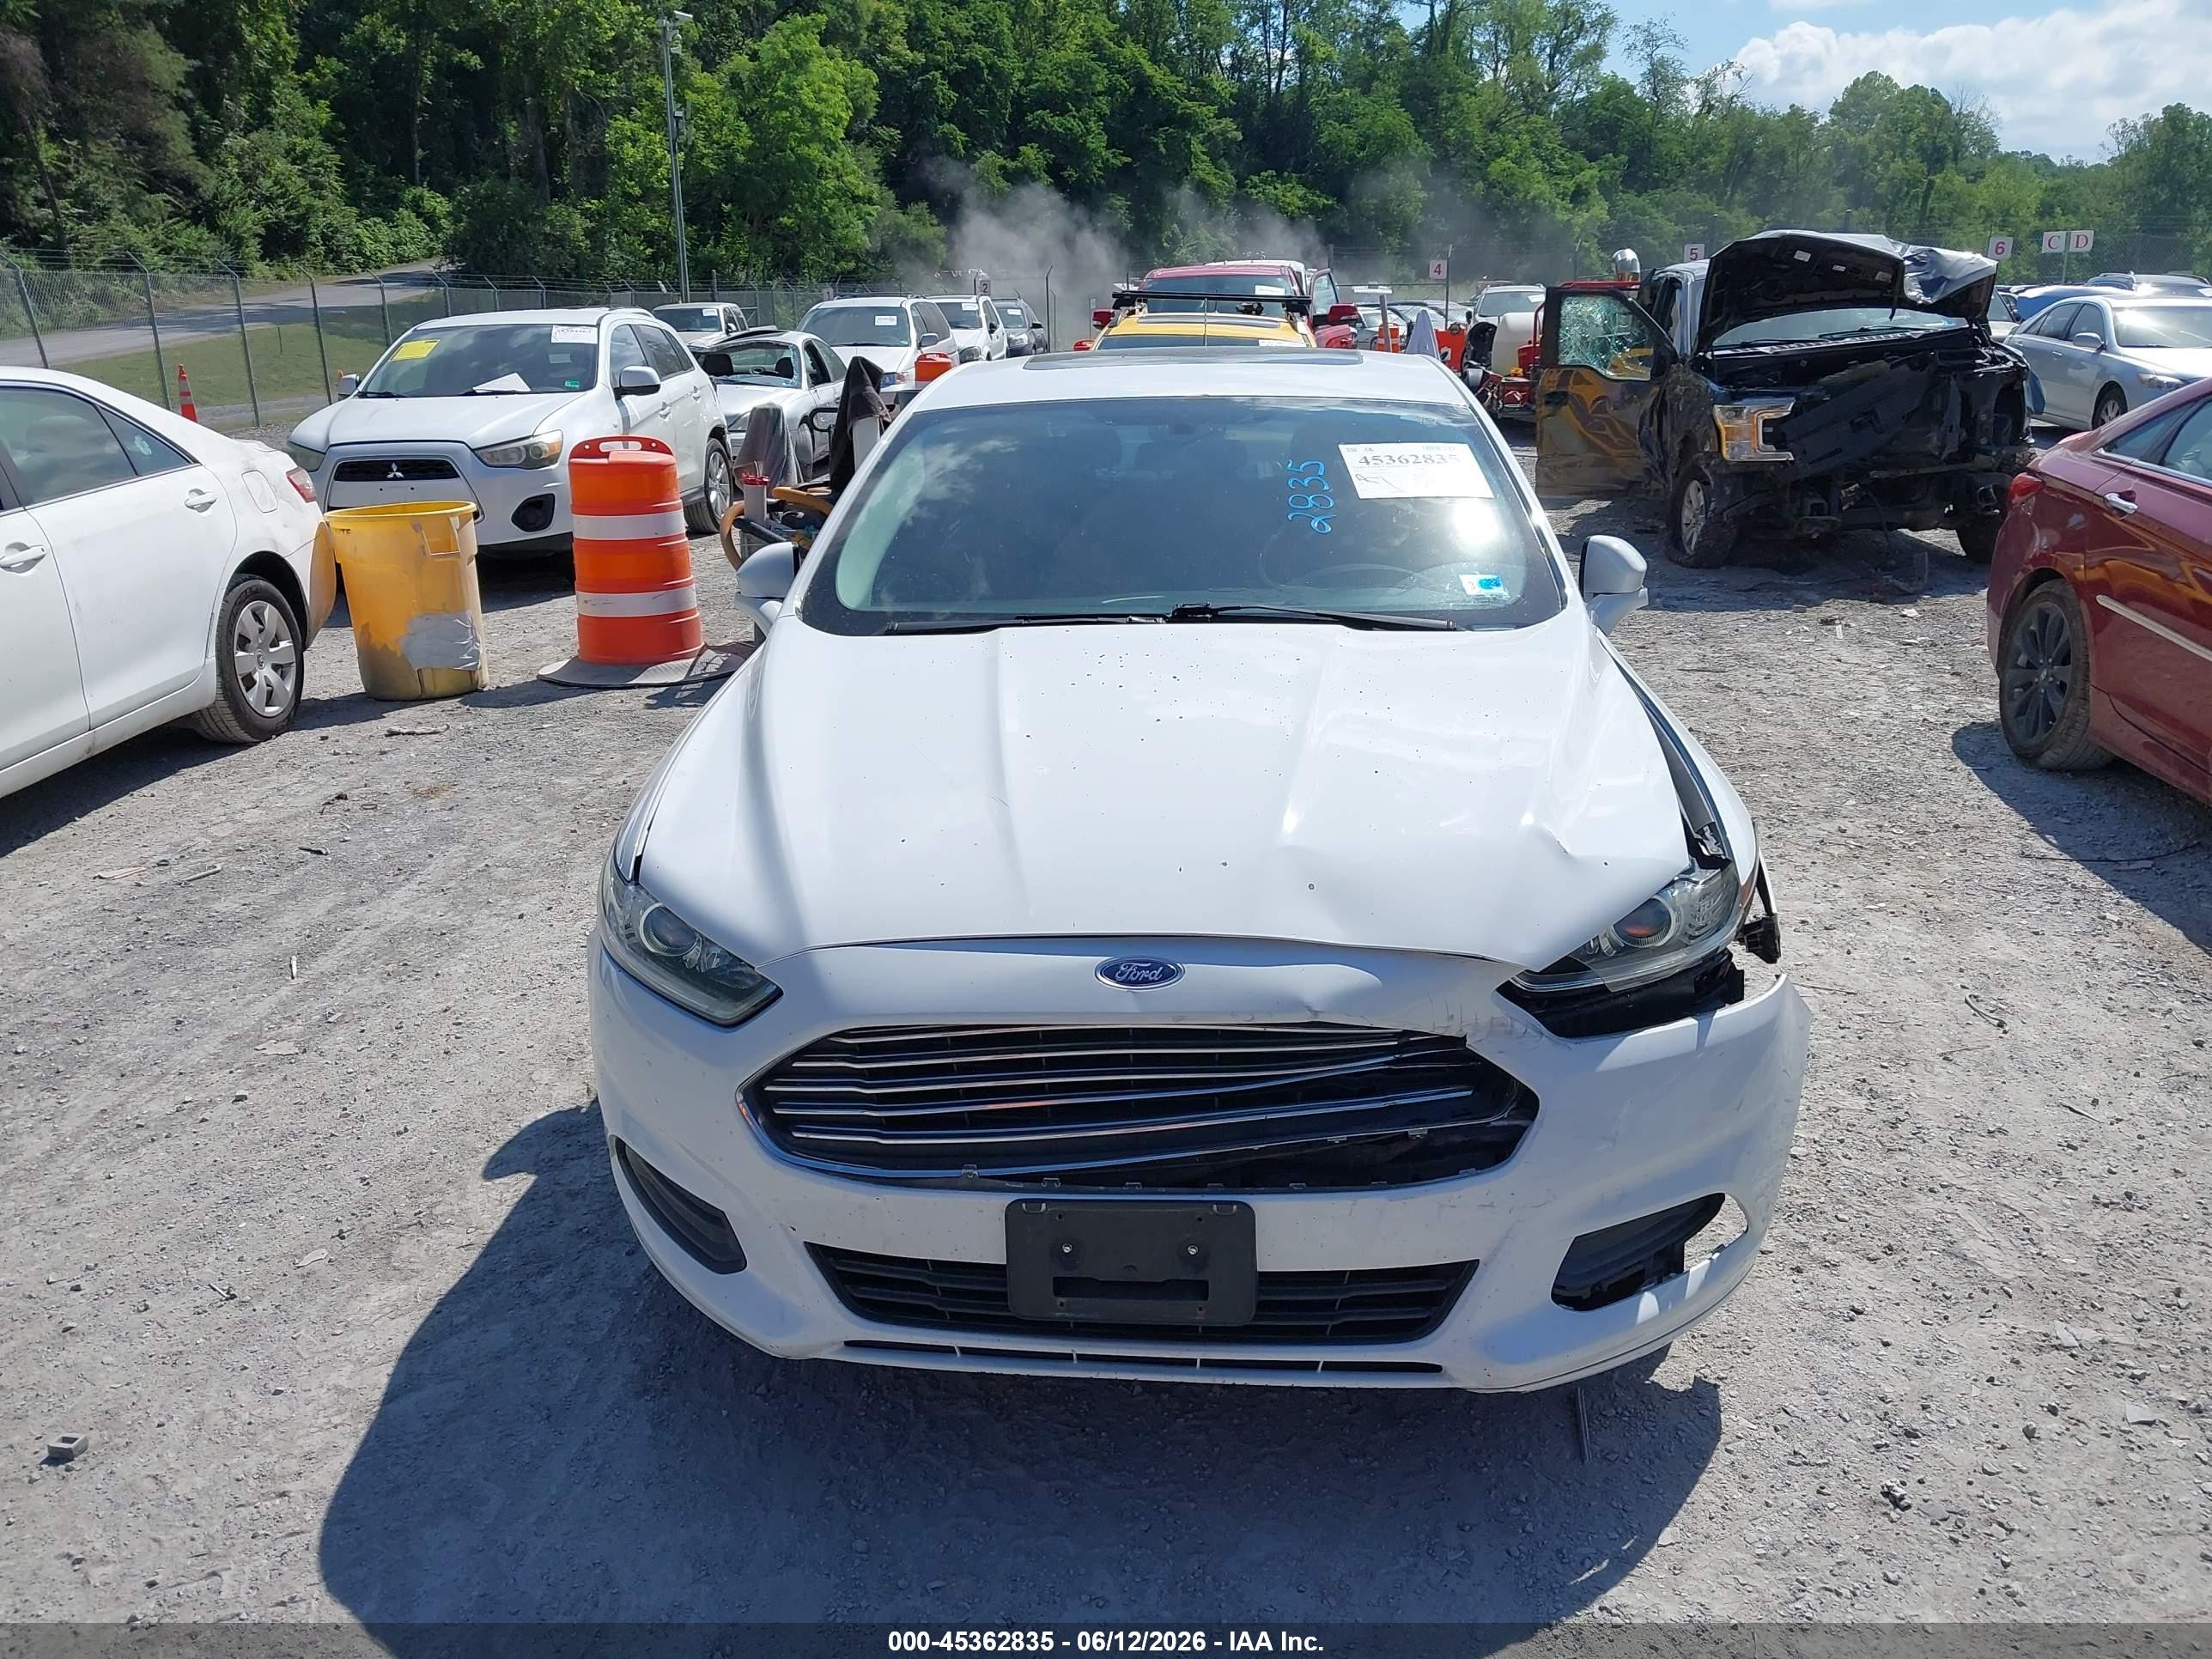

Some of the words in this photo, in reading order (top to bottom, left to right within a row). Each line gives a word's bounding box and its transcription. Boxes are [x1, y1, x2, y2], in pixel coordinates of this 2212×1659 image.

[1995, 241, 2006, 255] 6
[2047, 234, 2061, 250] C
[2075, 234, 2089, 249] D
[1690, 247, 1698, 261] 5
[1434, 263, 1443, 276] 4
[981, 283, 988, 293] 2
[1358, 453, 1461, 466] 45362835
[1287, 458, 1337, 534] 2835
[1115, 962, 1164, 981] Ford
